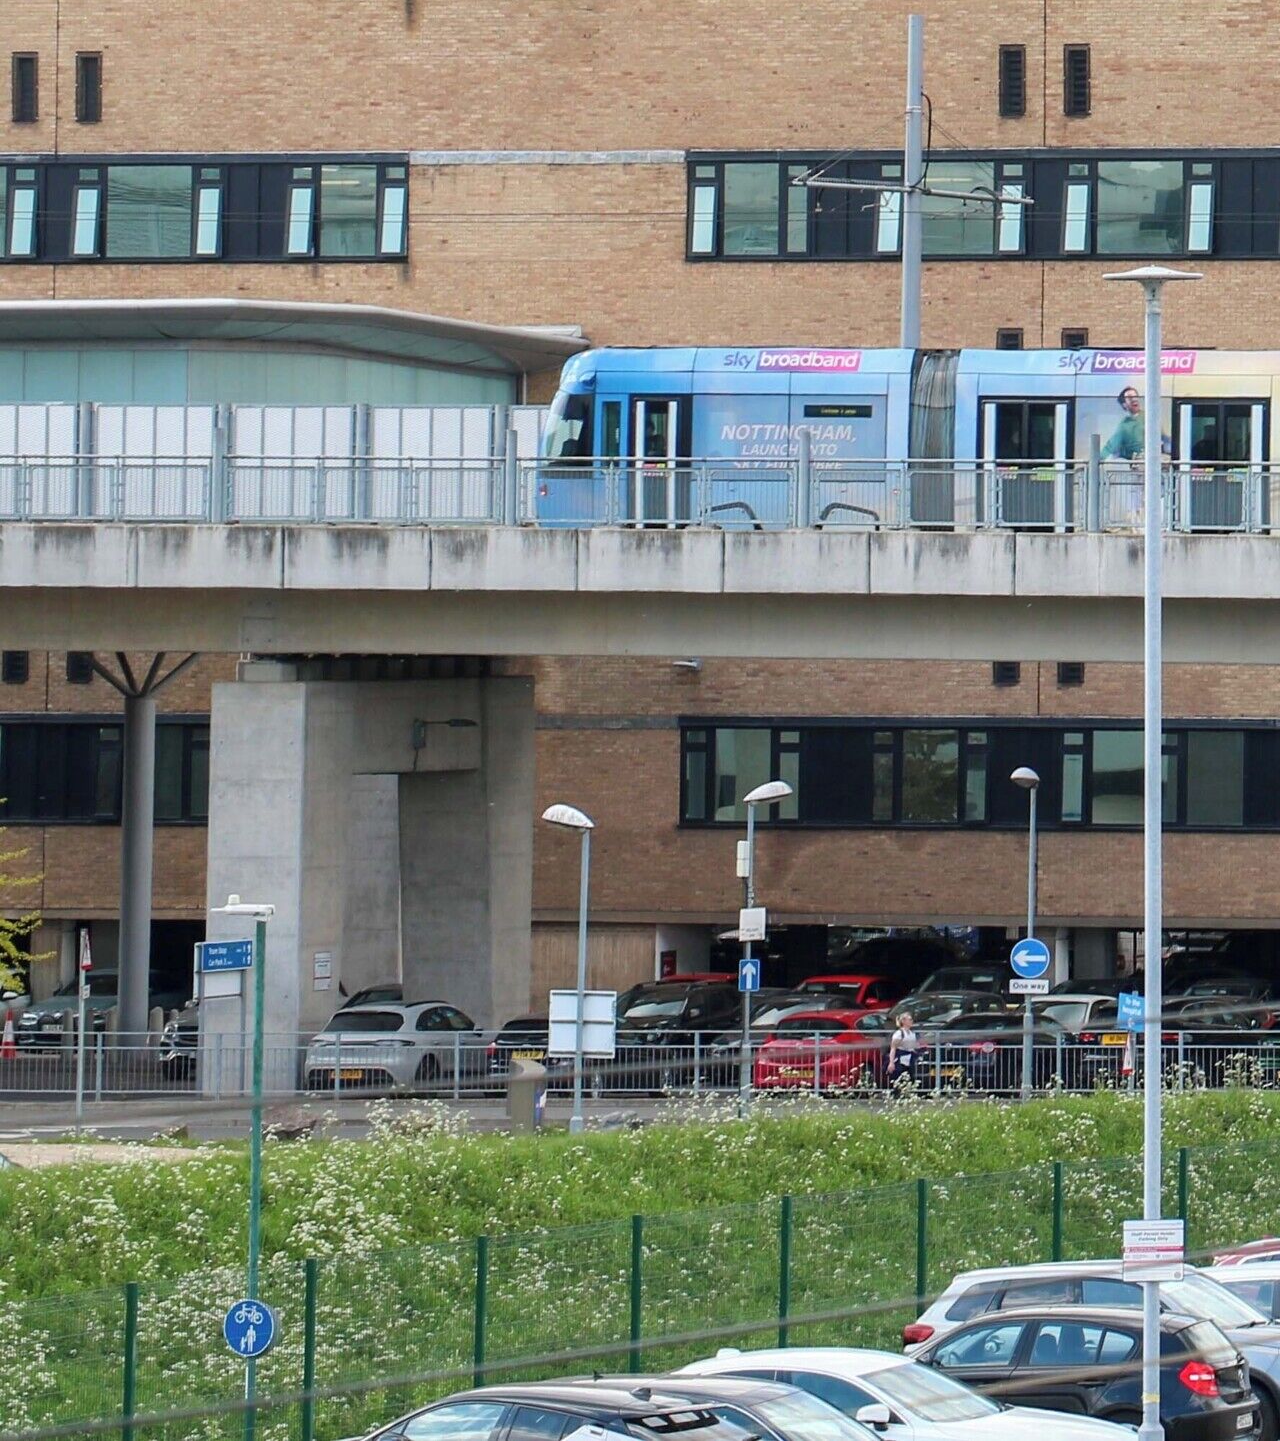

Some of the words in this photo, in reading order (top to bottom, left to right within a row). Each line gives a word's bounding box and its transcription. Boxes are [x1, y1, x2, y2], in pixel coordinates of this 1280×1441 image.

[724, 351, 755, 369] sky
[760, 352, 858, 367] broadband
[1058, 353, 1089, 370] sky
[1094, 354, 1193, 369] broadand
[808, 444, 838, 456] NTO
[1012, 981, 1029, 990] One
[1030, 983, 1046, 992] way
